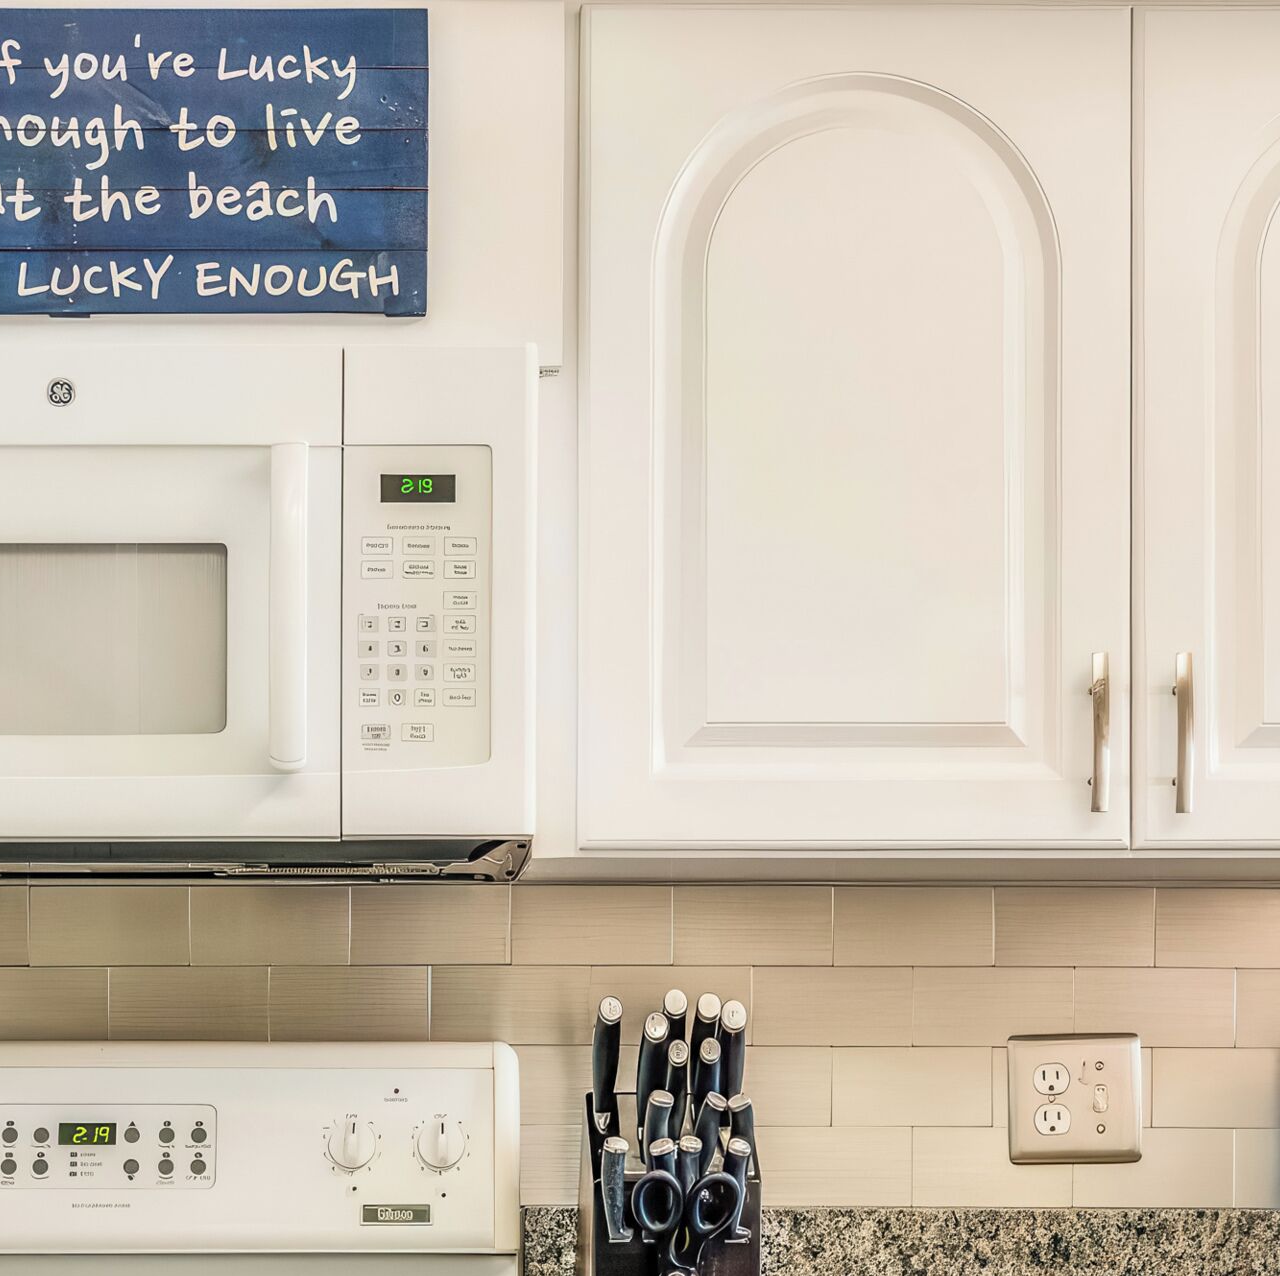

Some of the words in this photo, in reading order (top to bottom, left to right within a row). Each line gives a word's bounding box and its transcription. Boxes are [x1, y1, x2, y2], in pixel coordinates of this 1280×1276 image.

[43, 33, 196, 99] you're
[217, 46, 358, 100] Lucky
[170, 107, 237, 151] to
[266, 104, 362, 151] live
[63, 176, 162, 222] the
[187, 171, 339, 225] beach
[16, 255, 175, 299] LUCKY
[194, 258, 401, 299] ENOUGH
